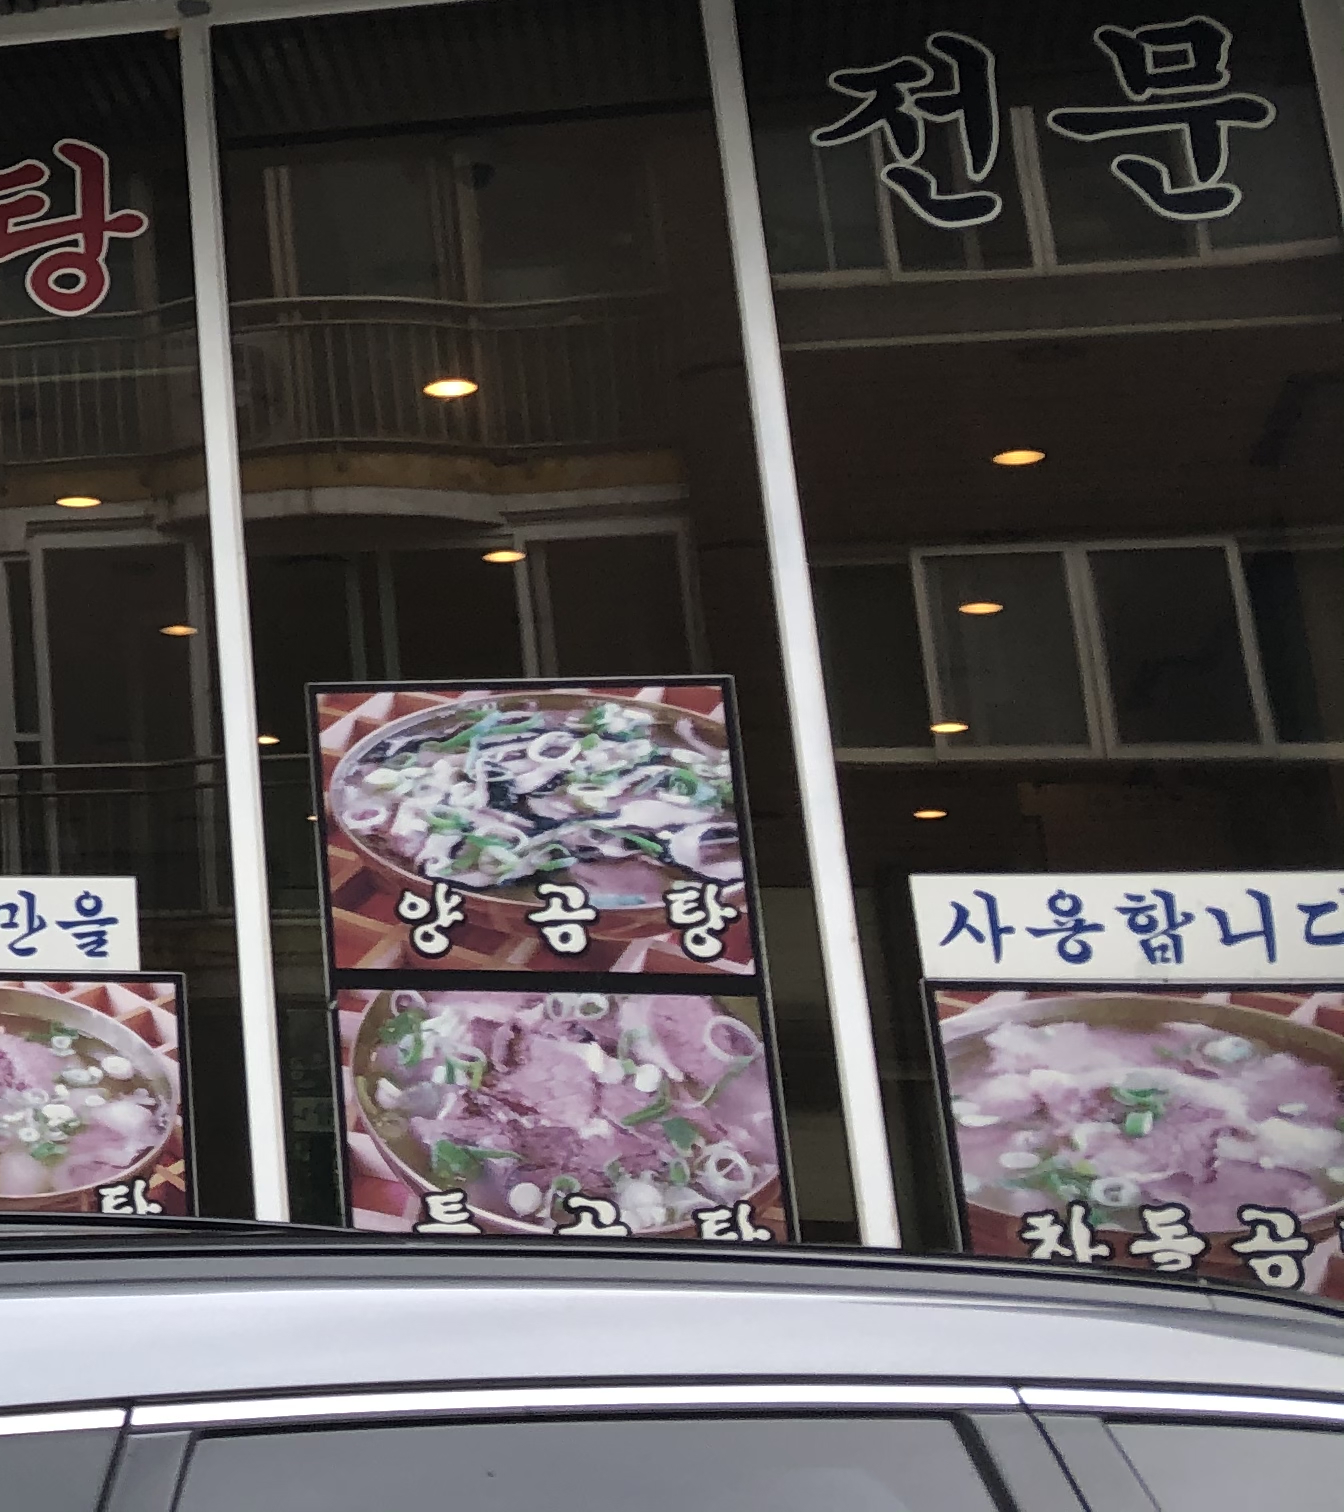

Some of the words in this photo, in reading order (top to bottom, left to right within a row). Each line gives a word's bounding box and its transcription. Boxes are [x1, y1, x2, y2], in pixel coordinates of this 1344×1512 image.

[812, 15, 1277, 228] 전문
[397, 882, 739, 959] 양곰탕
[1021, 1200, 1344, 1290] 차돌곰
